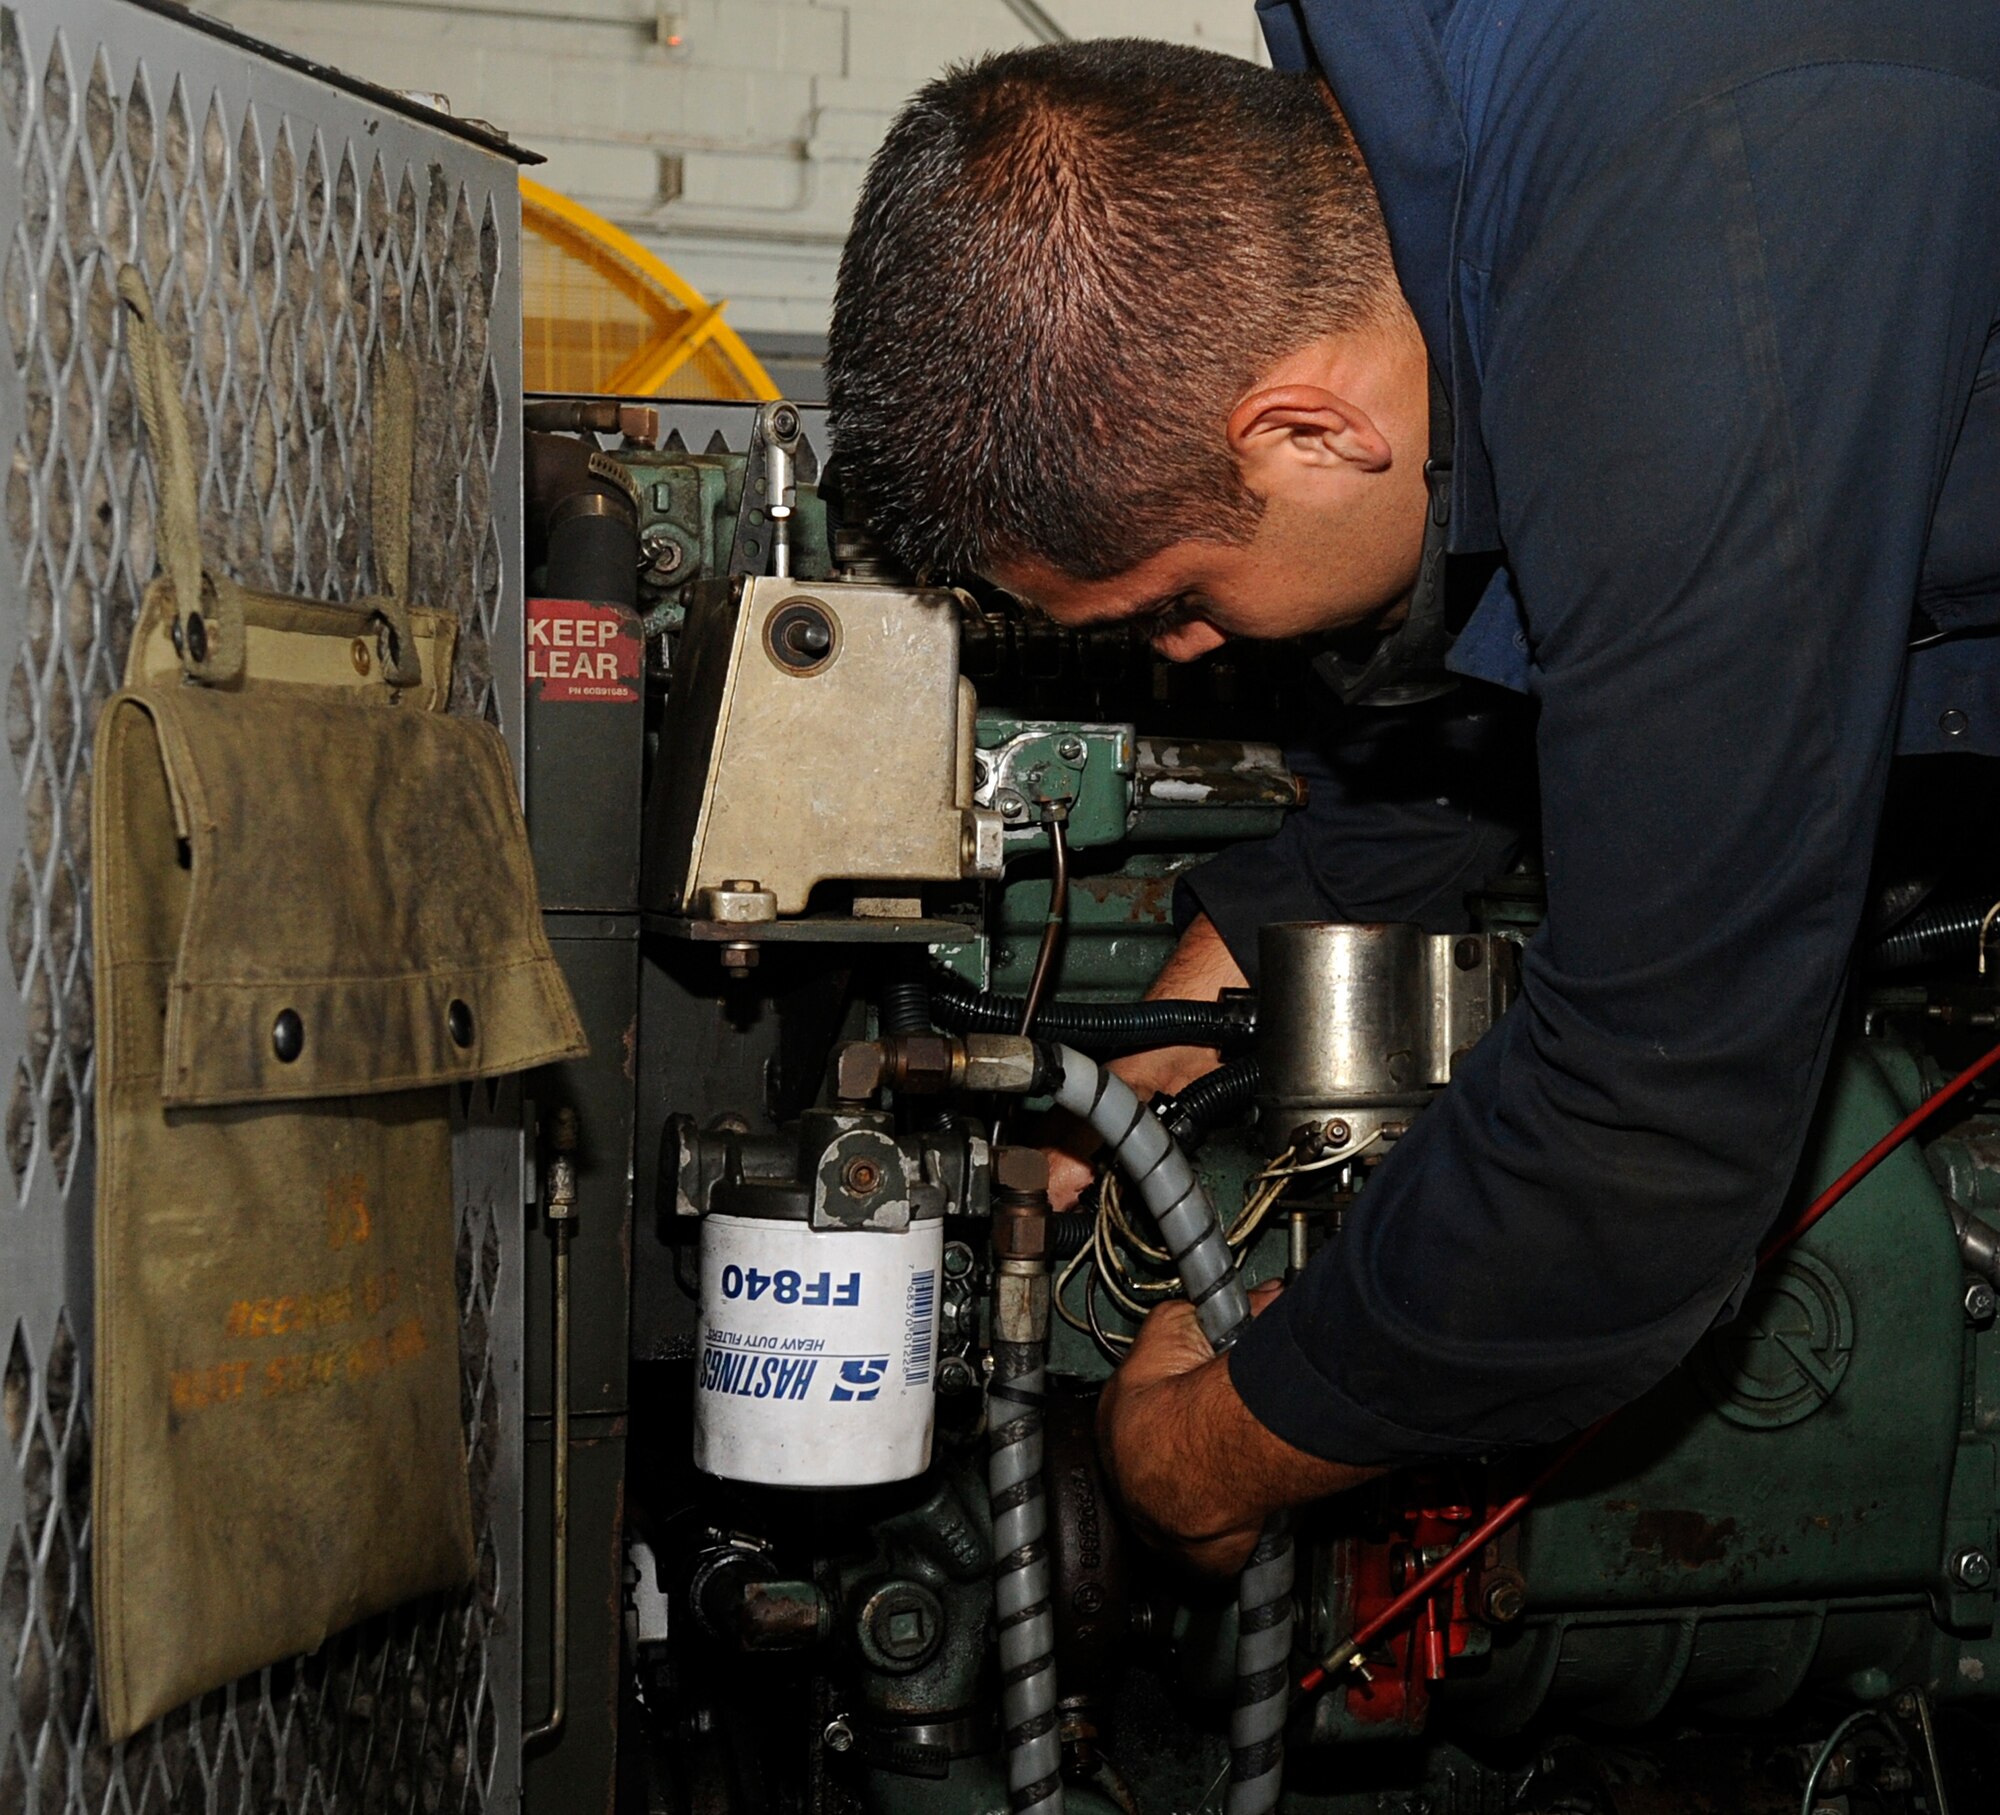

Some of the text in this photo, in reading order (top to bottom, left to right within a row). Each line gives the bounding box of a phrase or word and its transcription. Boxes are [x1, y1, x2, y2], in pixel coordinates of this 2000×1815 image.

[527, 618, 619, 648] KEEP
[528, 651, 619, 680] LEAR
[721, 1264, 862, 1307] FF840
[706, 1328, 826, 1352] HEAVY DUTY FILTERS
[700, 1348, 818, 1401] HASTINGS
